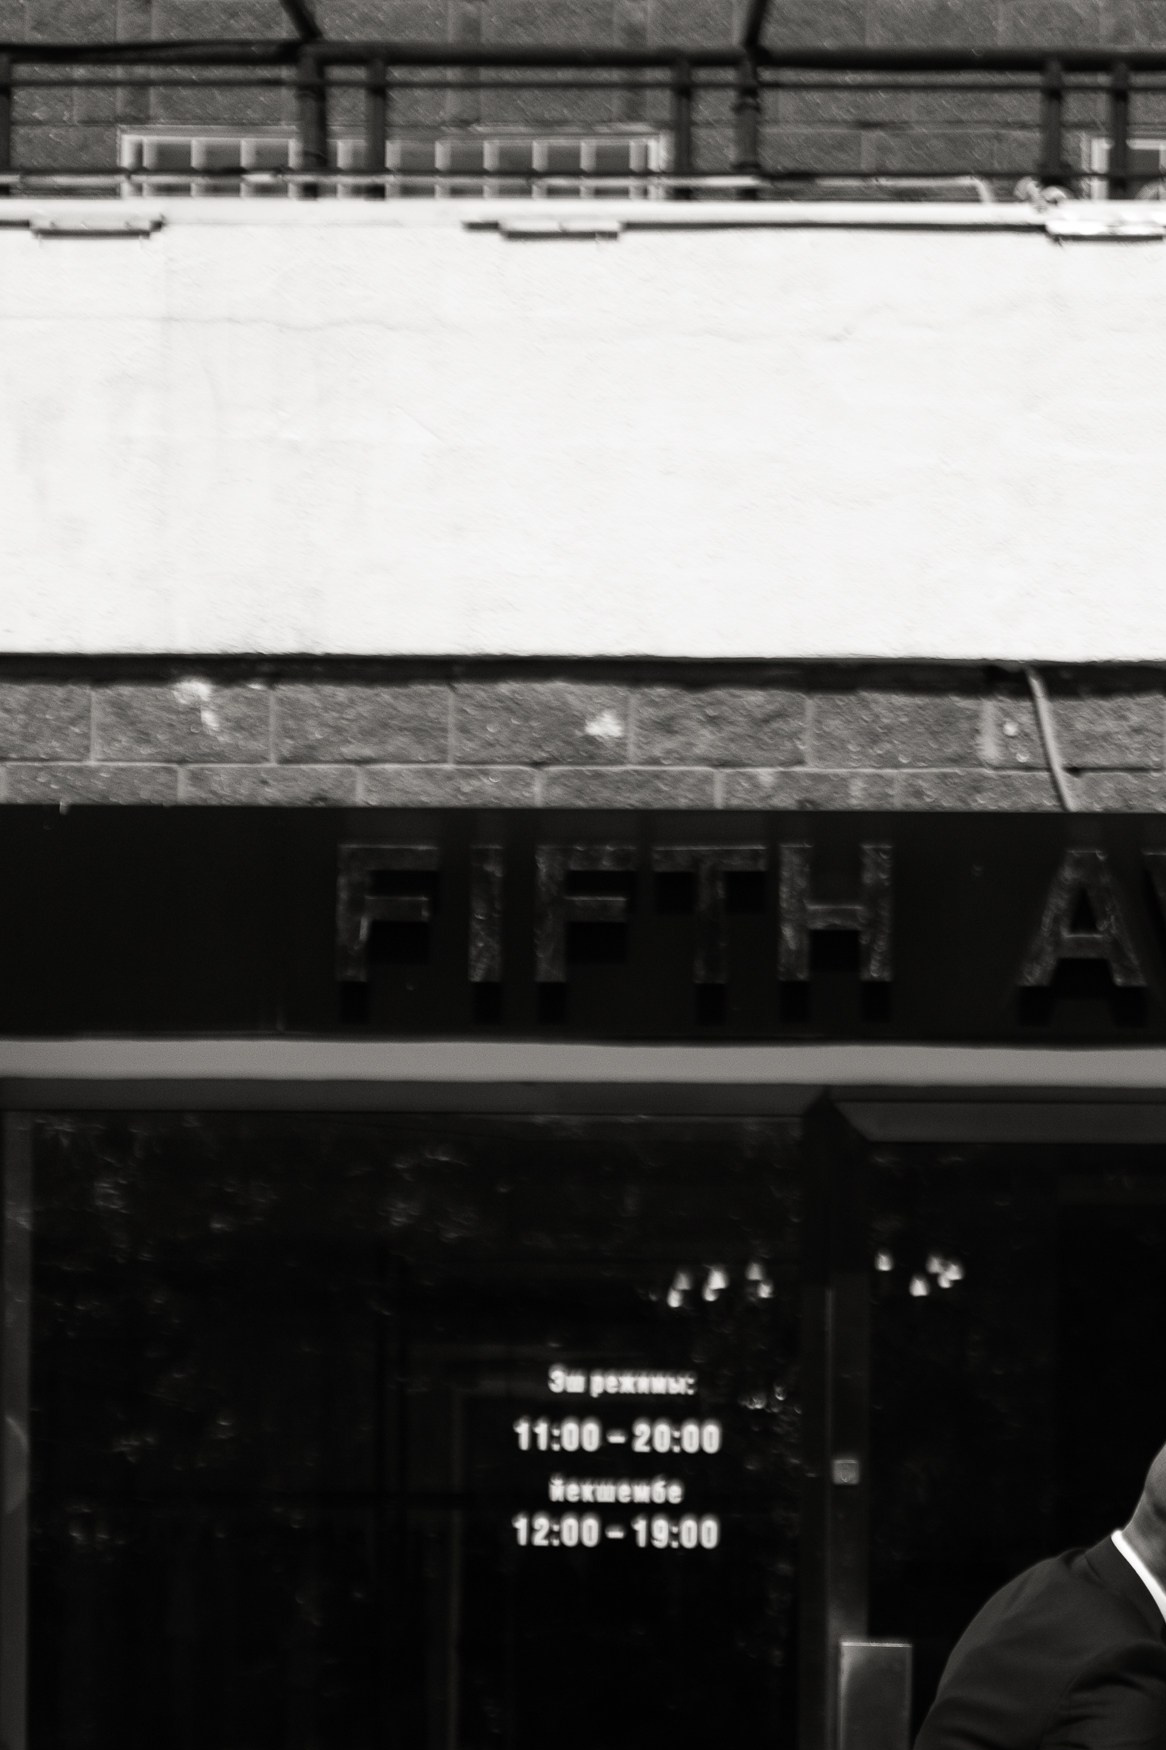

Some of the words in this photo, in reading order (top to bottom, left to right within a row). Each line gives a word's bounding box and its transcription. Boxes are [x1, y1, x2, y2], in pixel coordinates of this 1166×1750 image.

[336, 843, 895, 986] FIFTH
[514, 1419, 601, 1452] 11:00
[632, 1420, 721, 1454] 20:00
[513, 1514, 600, 1547] 12:00
[632, 1516, 719, 1549] 19:00
